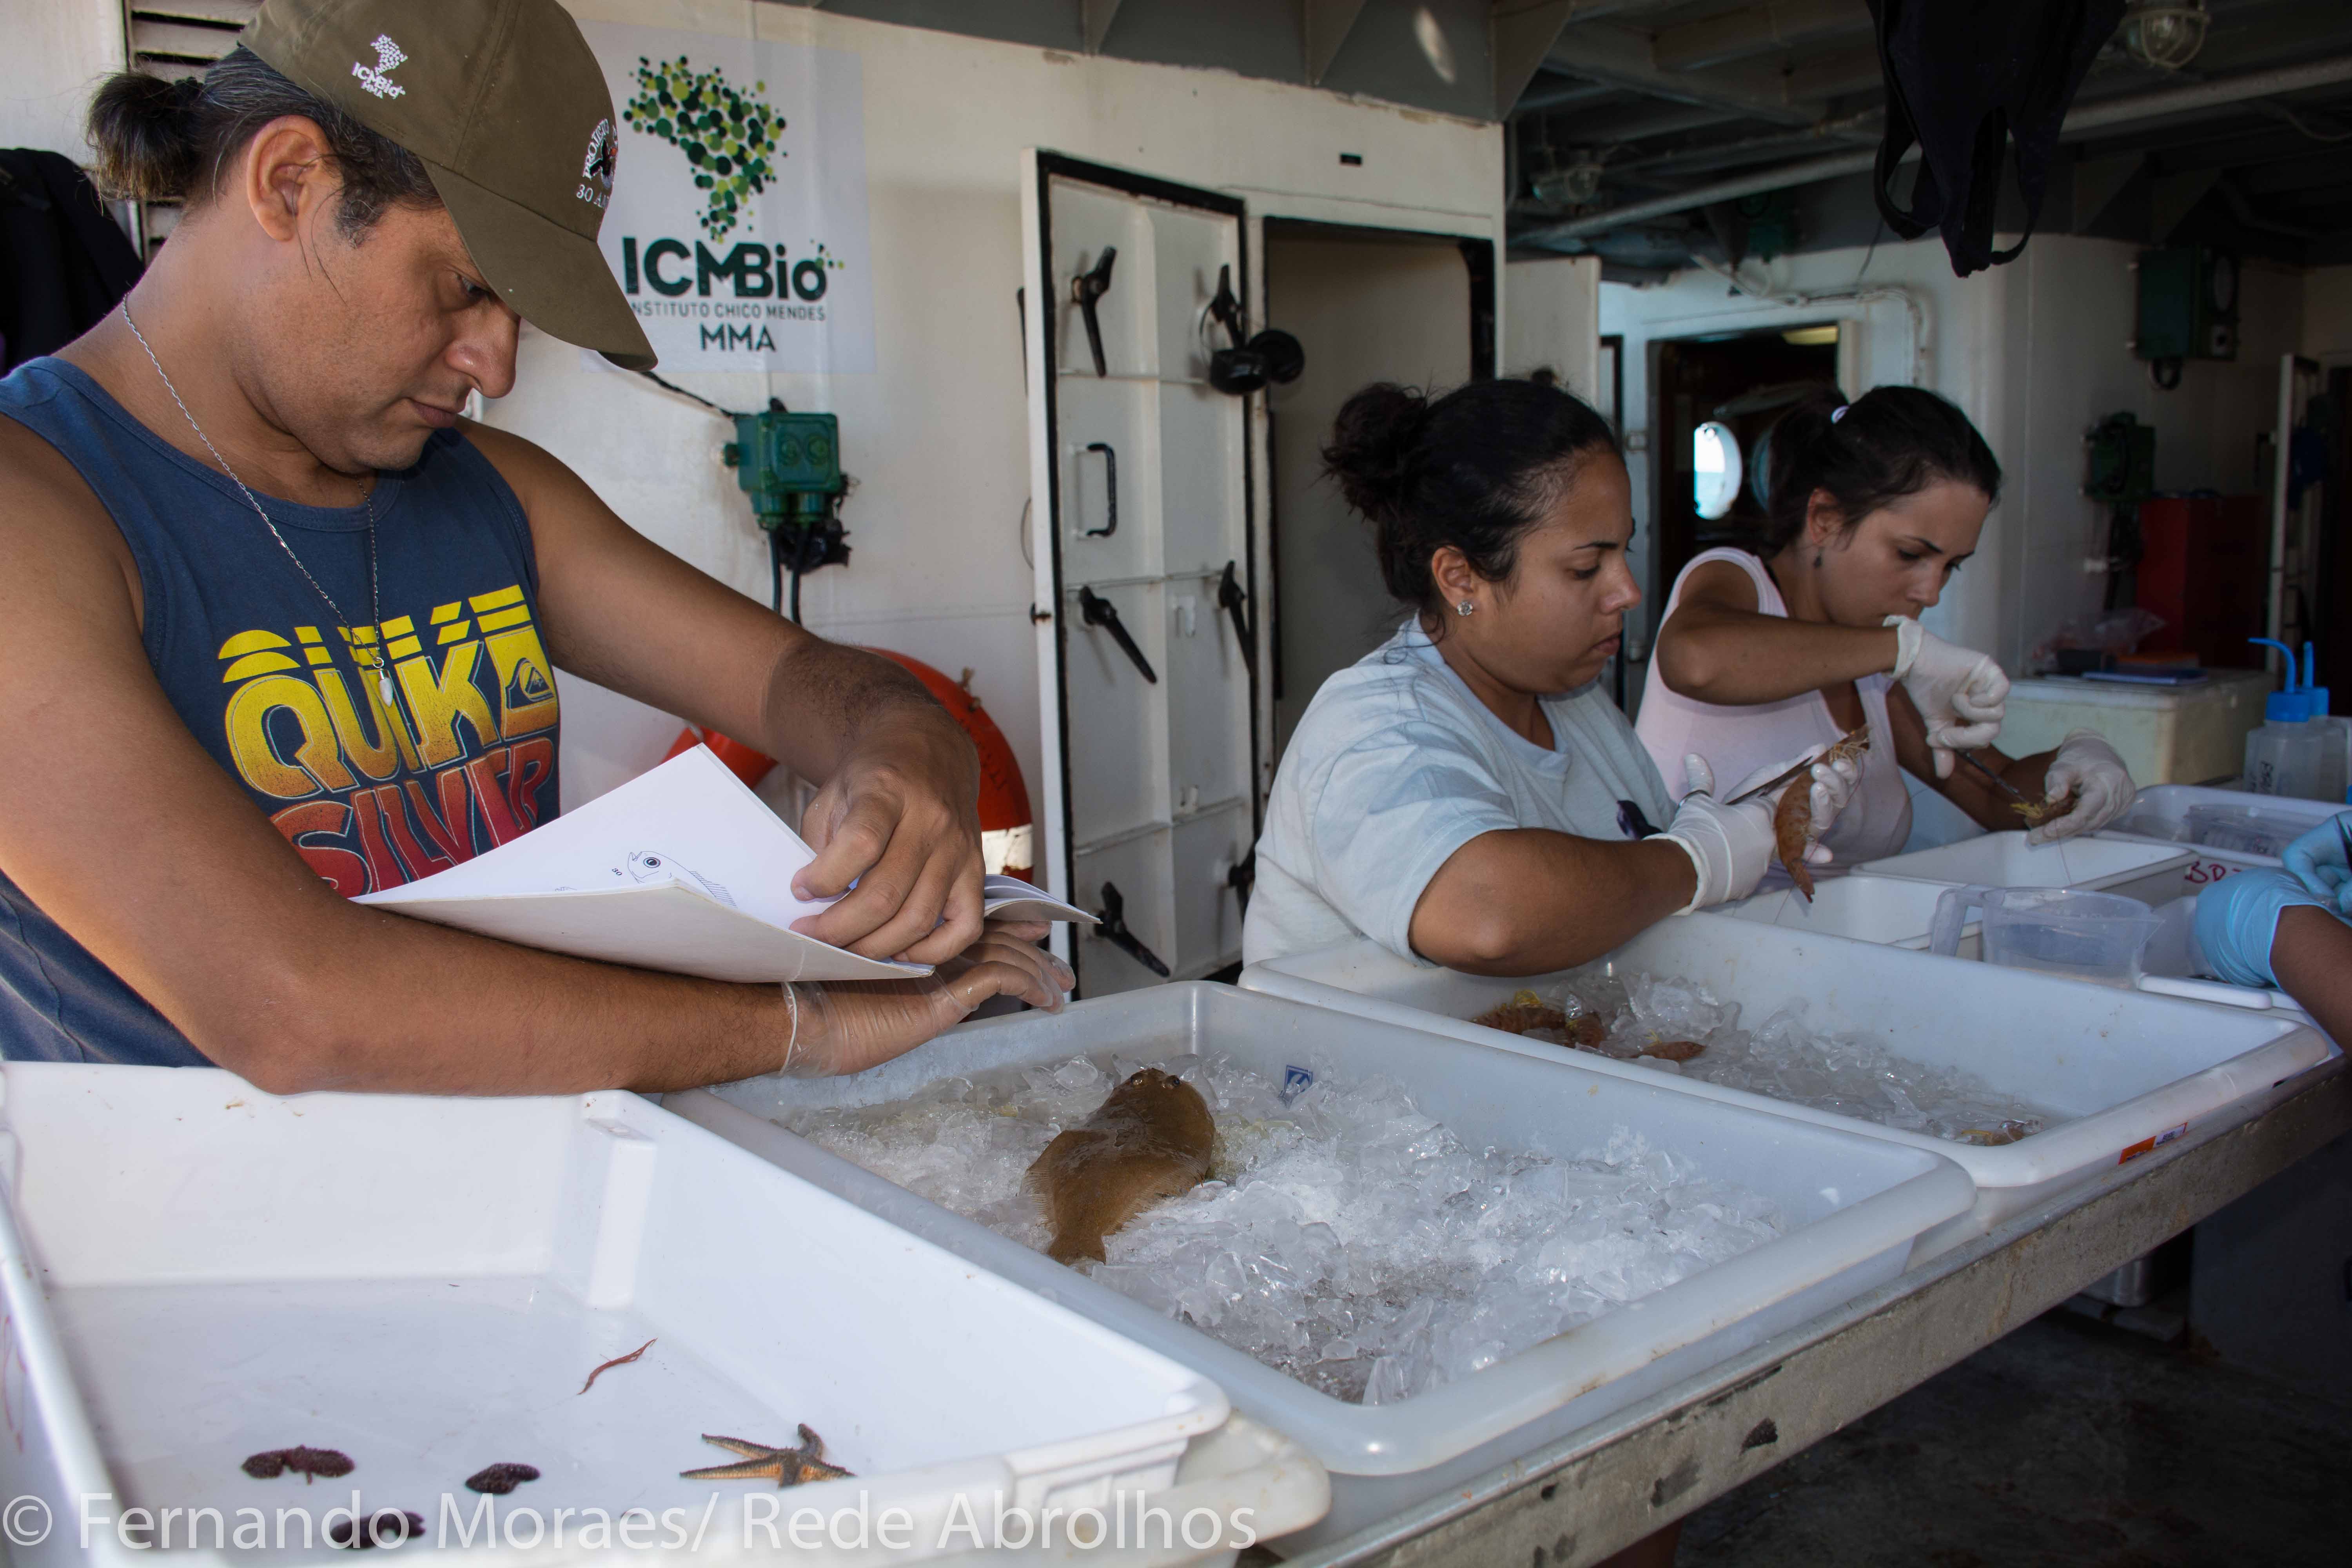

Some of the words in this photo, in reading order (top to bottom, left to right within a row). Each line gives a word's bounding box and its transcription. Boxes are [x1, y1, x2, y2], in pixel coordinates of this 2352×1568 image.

[352, 62, 401, 98] ICMBio
[360, 81, 383, 99] MMA
[576, 184, 593, 202] 30
[622, 236, 828, 302] ICMBio
[632, 301, 710, 318] NSTITUTO
[714, 304, 762, 319] CHICO
[766, 306, 827, 321] MENDES
[700, 322, 776, 352] MMA
[612, 867, 622, 877] 30
